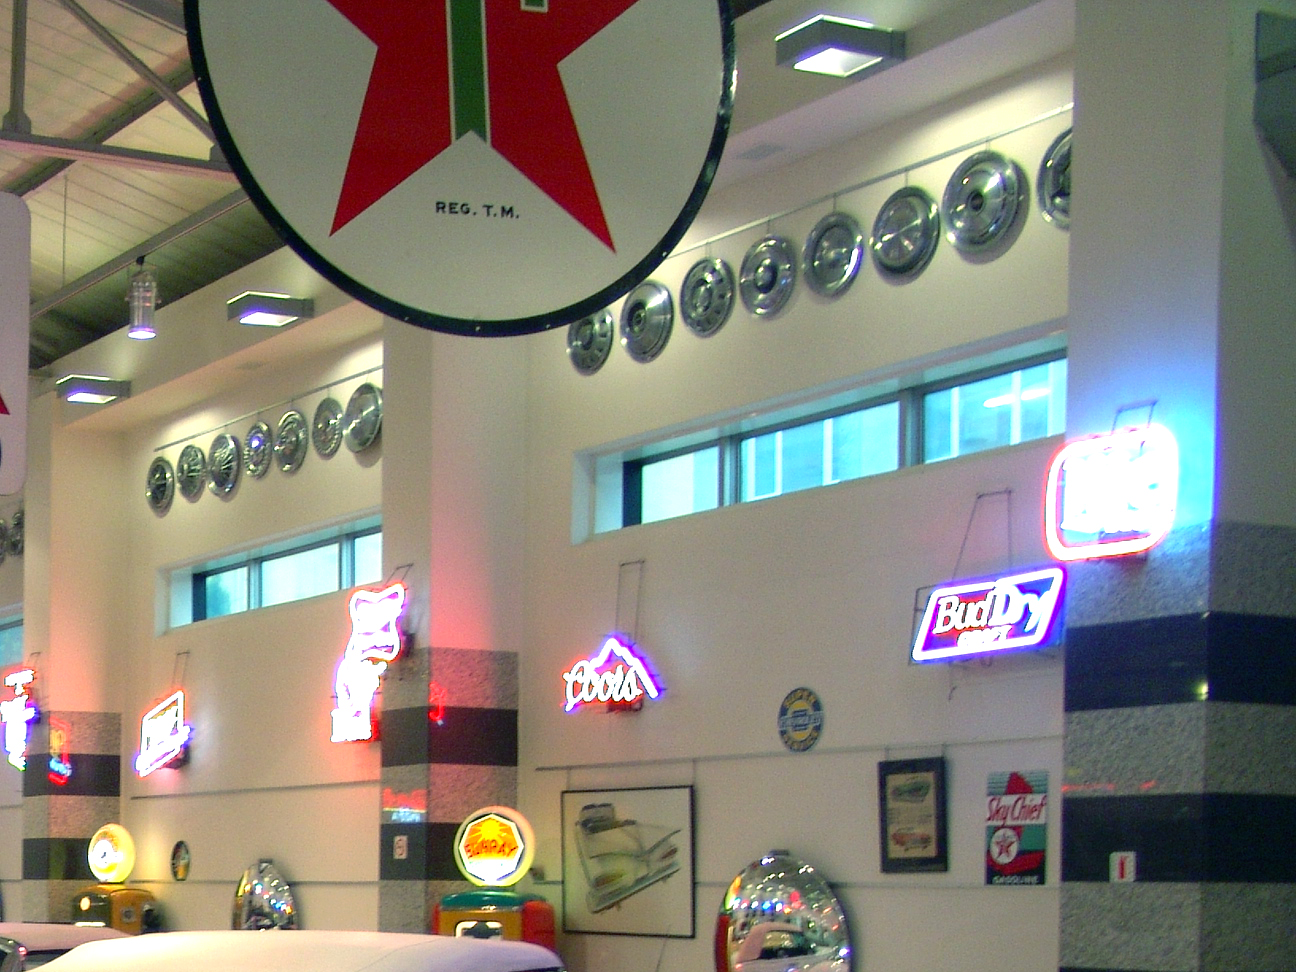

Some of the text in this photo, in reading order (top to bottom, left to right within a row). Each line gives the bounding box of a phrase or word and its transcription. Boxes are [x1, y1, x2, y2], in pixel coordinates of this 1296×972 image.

[435, 200, 520, 219] REG. T.M.
[932, 579, 1054, 635] Bud Dry
[562, 658, 644, 704] Coors
[986, 793, 1048, 828] Sky Chief
